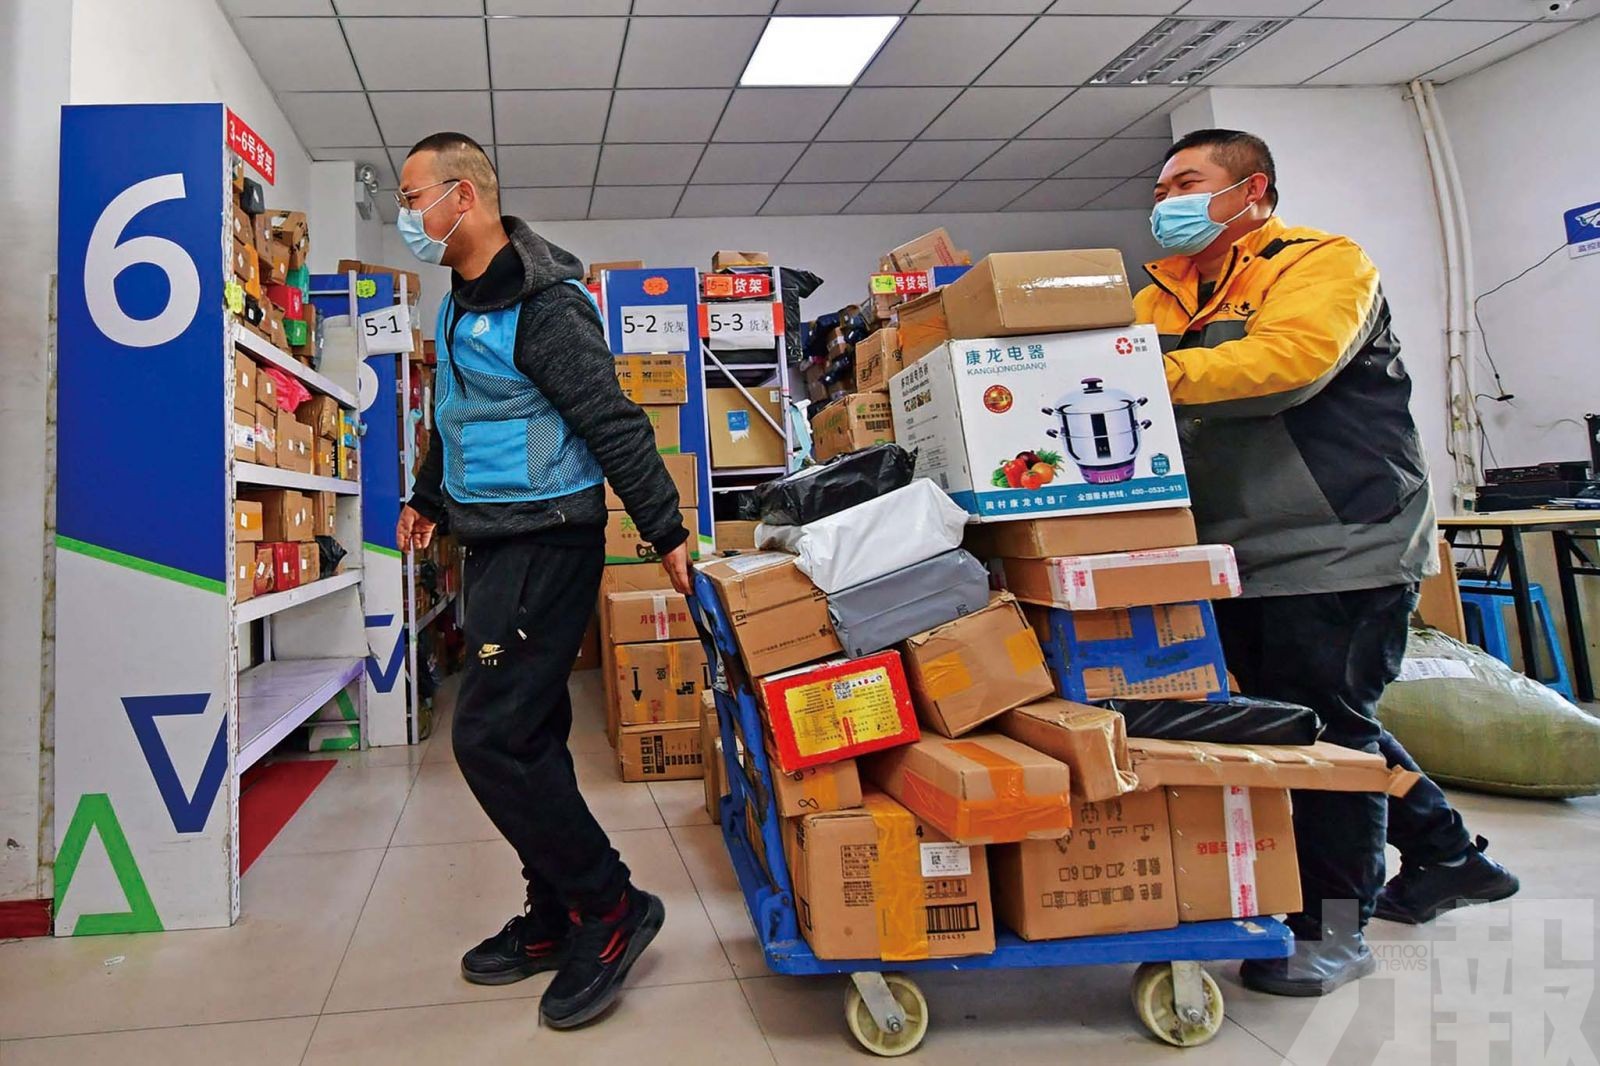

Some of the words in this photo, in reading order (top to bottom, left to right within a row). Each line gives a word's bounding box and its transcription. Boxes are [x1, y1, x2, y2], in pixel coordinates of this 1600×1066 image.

[84, 172, 201, 348] 6
[734, 278, 763, 293] 货架
[365, 315, 402, 336] 5-1
[624, 315, 657, 334] 5-2
[663, 321, 686, 334] 货架
[711, 313, 744, 332] 5-3
[965, 344, 1045, 366] 康龙电器
